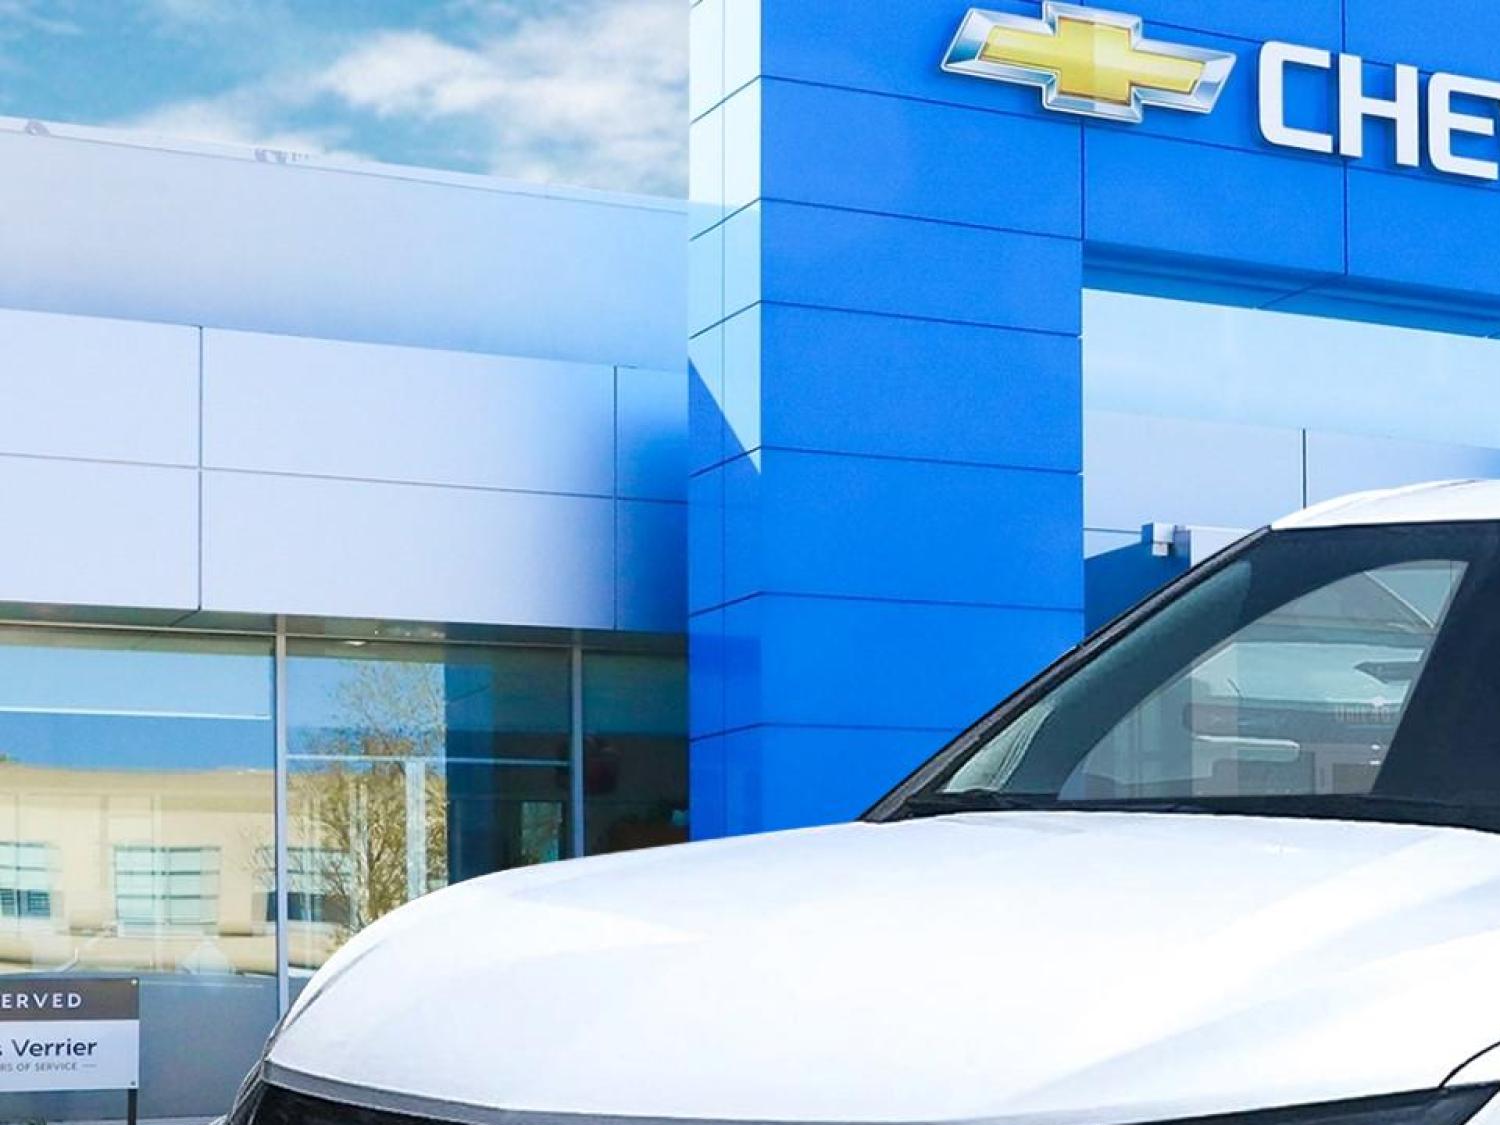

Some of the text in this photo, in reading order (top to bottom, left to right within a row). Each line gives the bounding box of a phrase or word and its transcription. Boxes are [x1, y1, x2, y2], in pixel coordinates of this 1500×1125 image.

[2, 993, 82, 1009] ERVED
[11, 1038, 98, 1057] Verrier
[16, 1062, 31, 1072] OF
[35, 1062, 77, 1072] SERVICE
